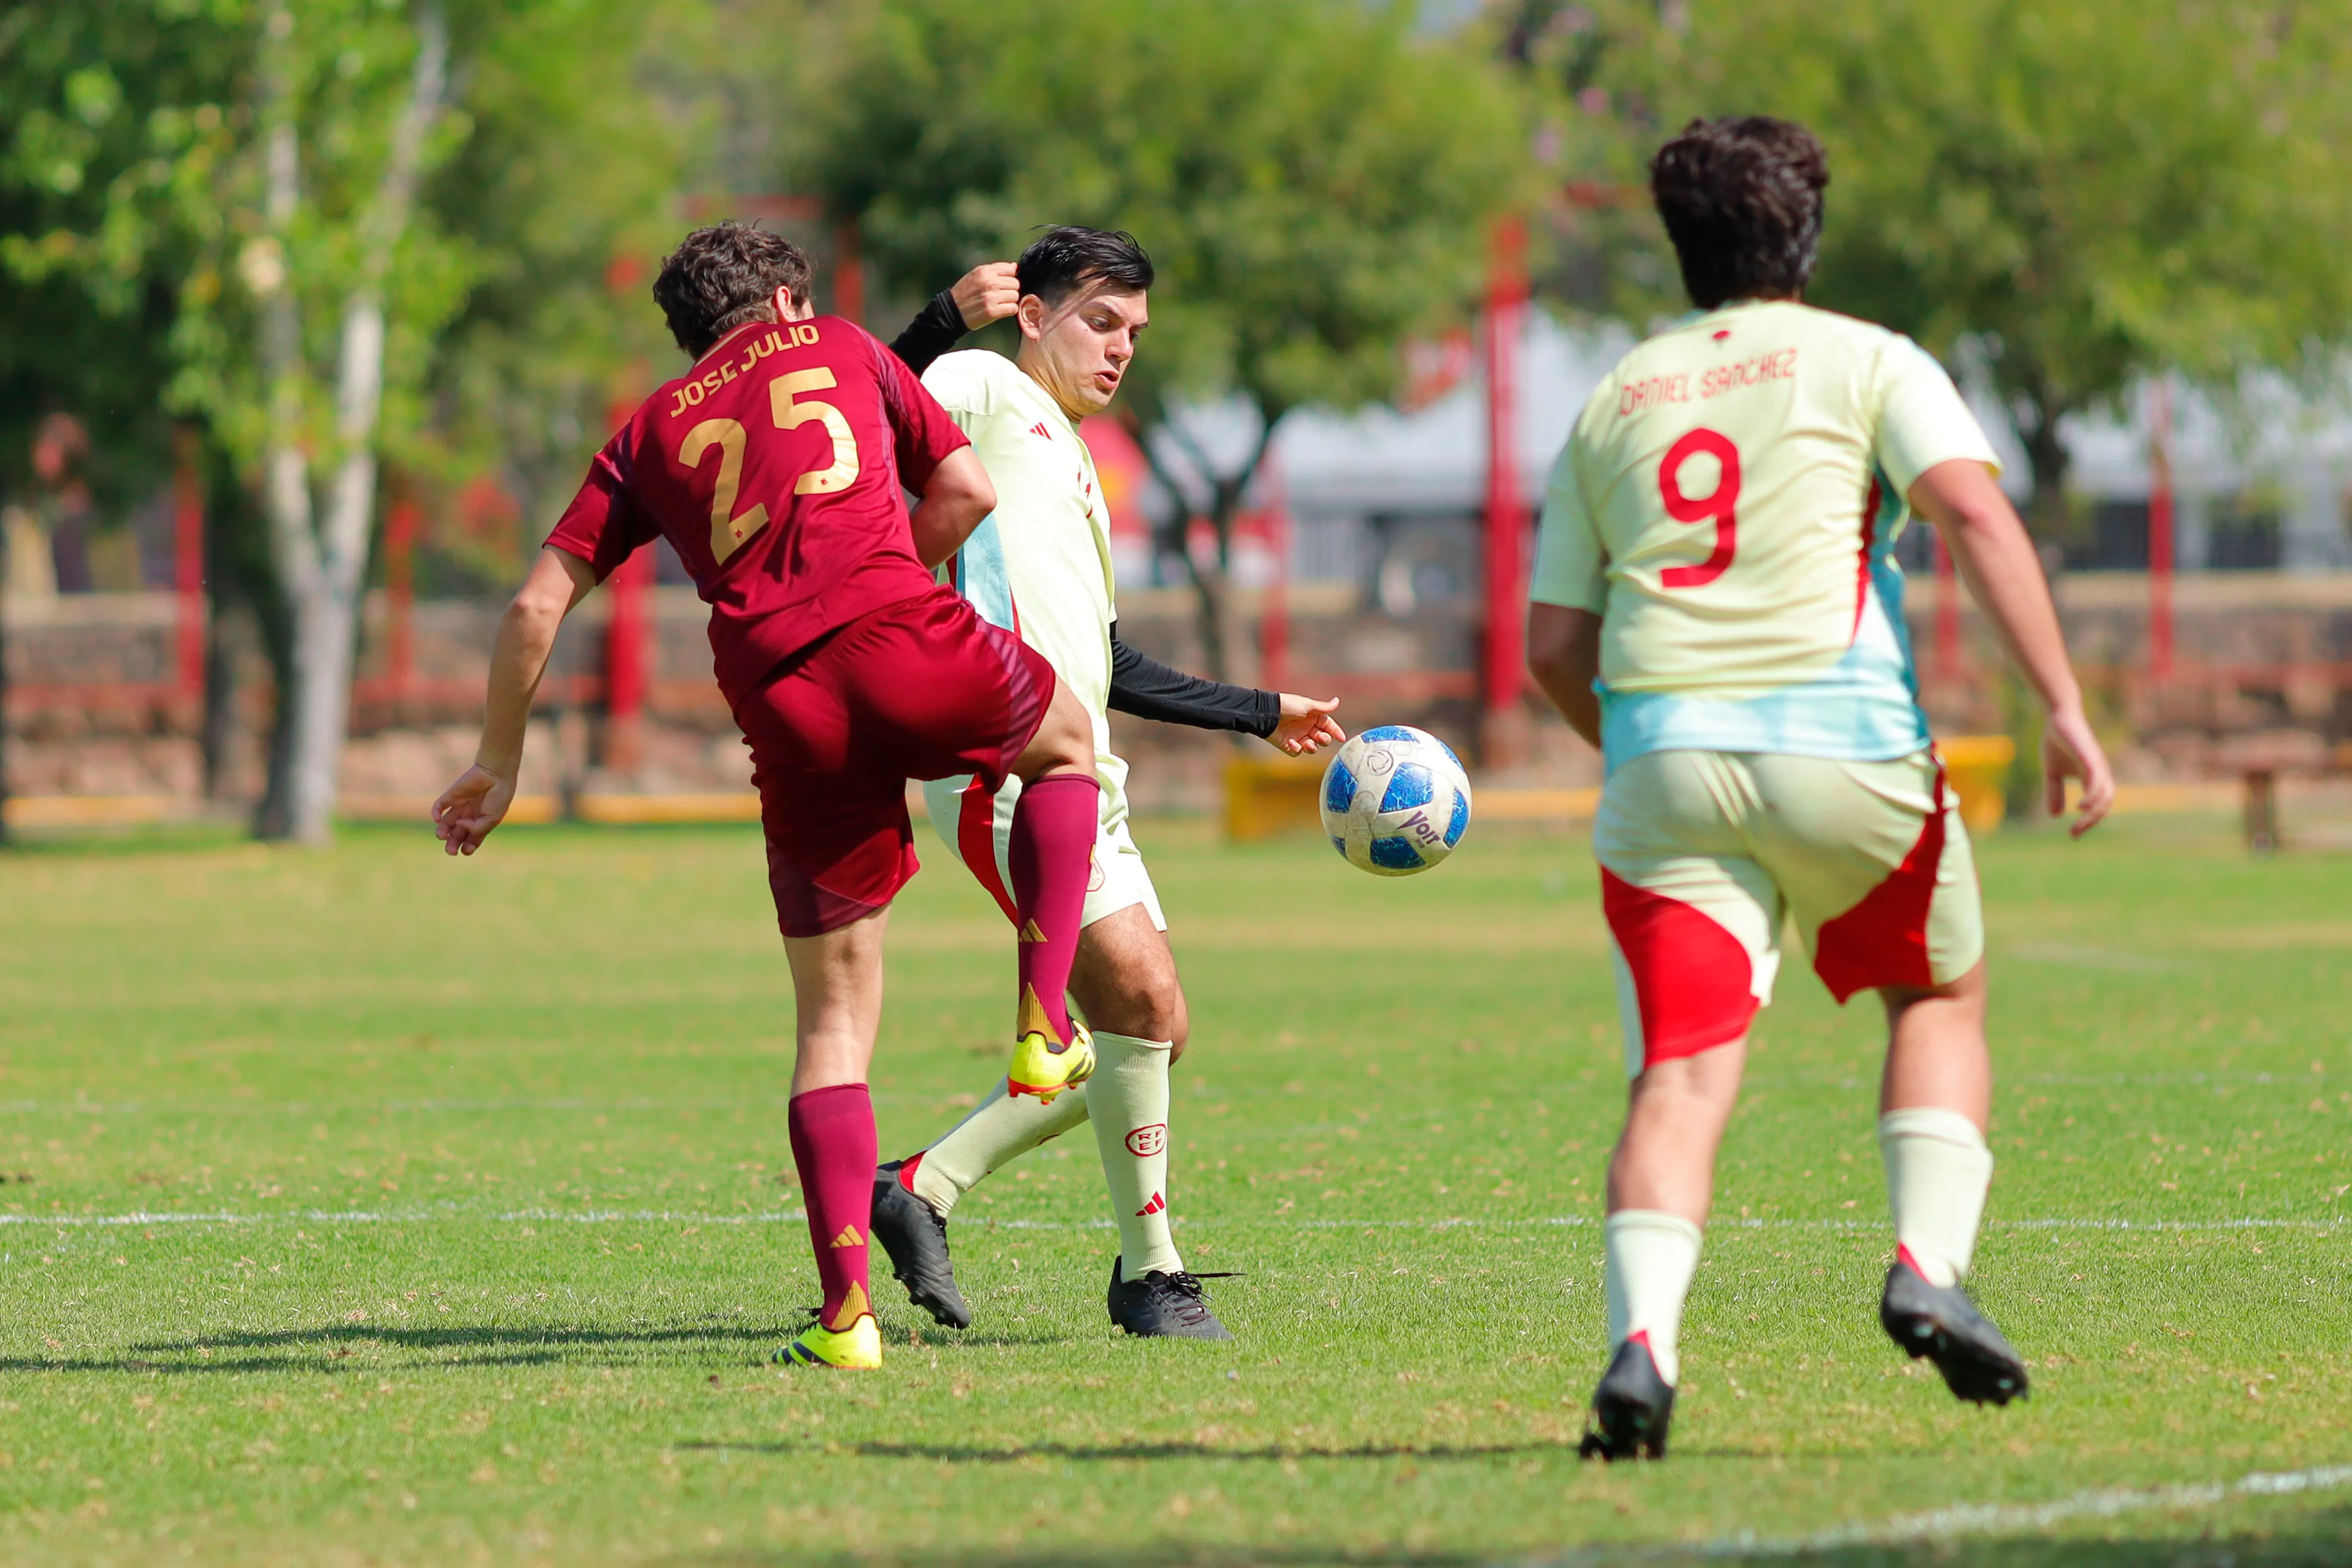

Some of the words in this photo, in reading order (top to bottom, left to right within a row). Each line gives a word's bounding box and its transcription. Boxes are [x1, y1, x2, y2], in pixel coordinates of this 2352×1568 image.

[670, 360, 738, 418] JOSE
[741, 324, 820, 372] JULIO
[1619, 374, 1690, 416] DANIEL
[679, 366, 860, 567] 25
[1658, 427, 1741, 589] 9
